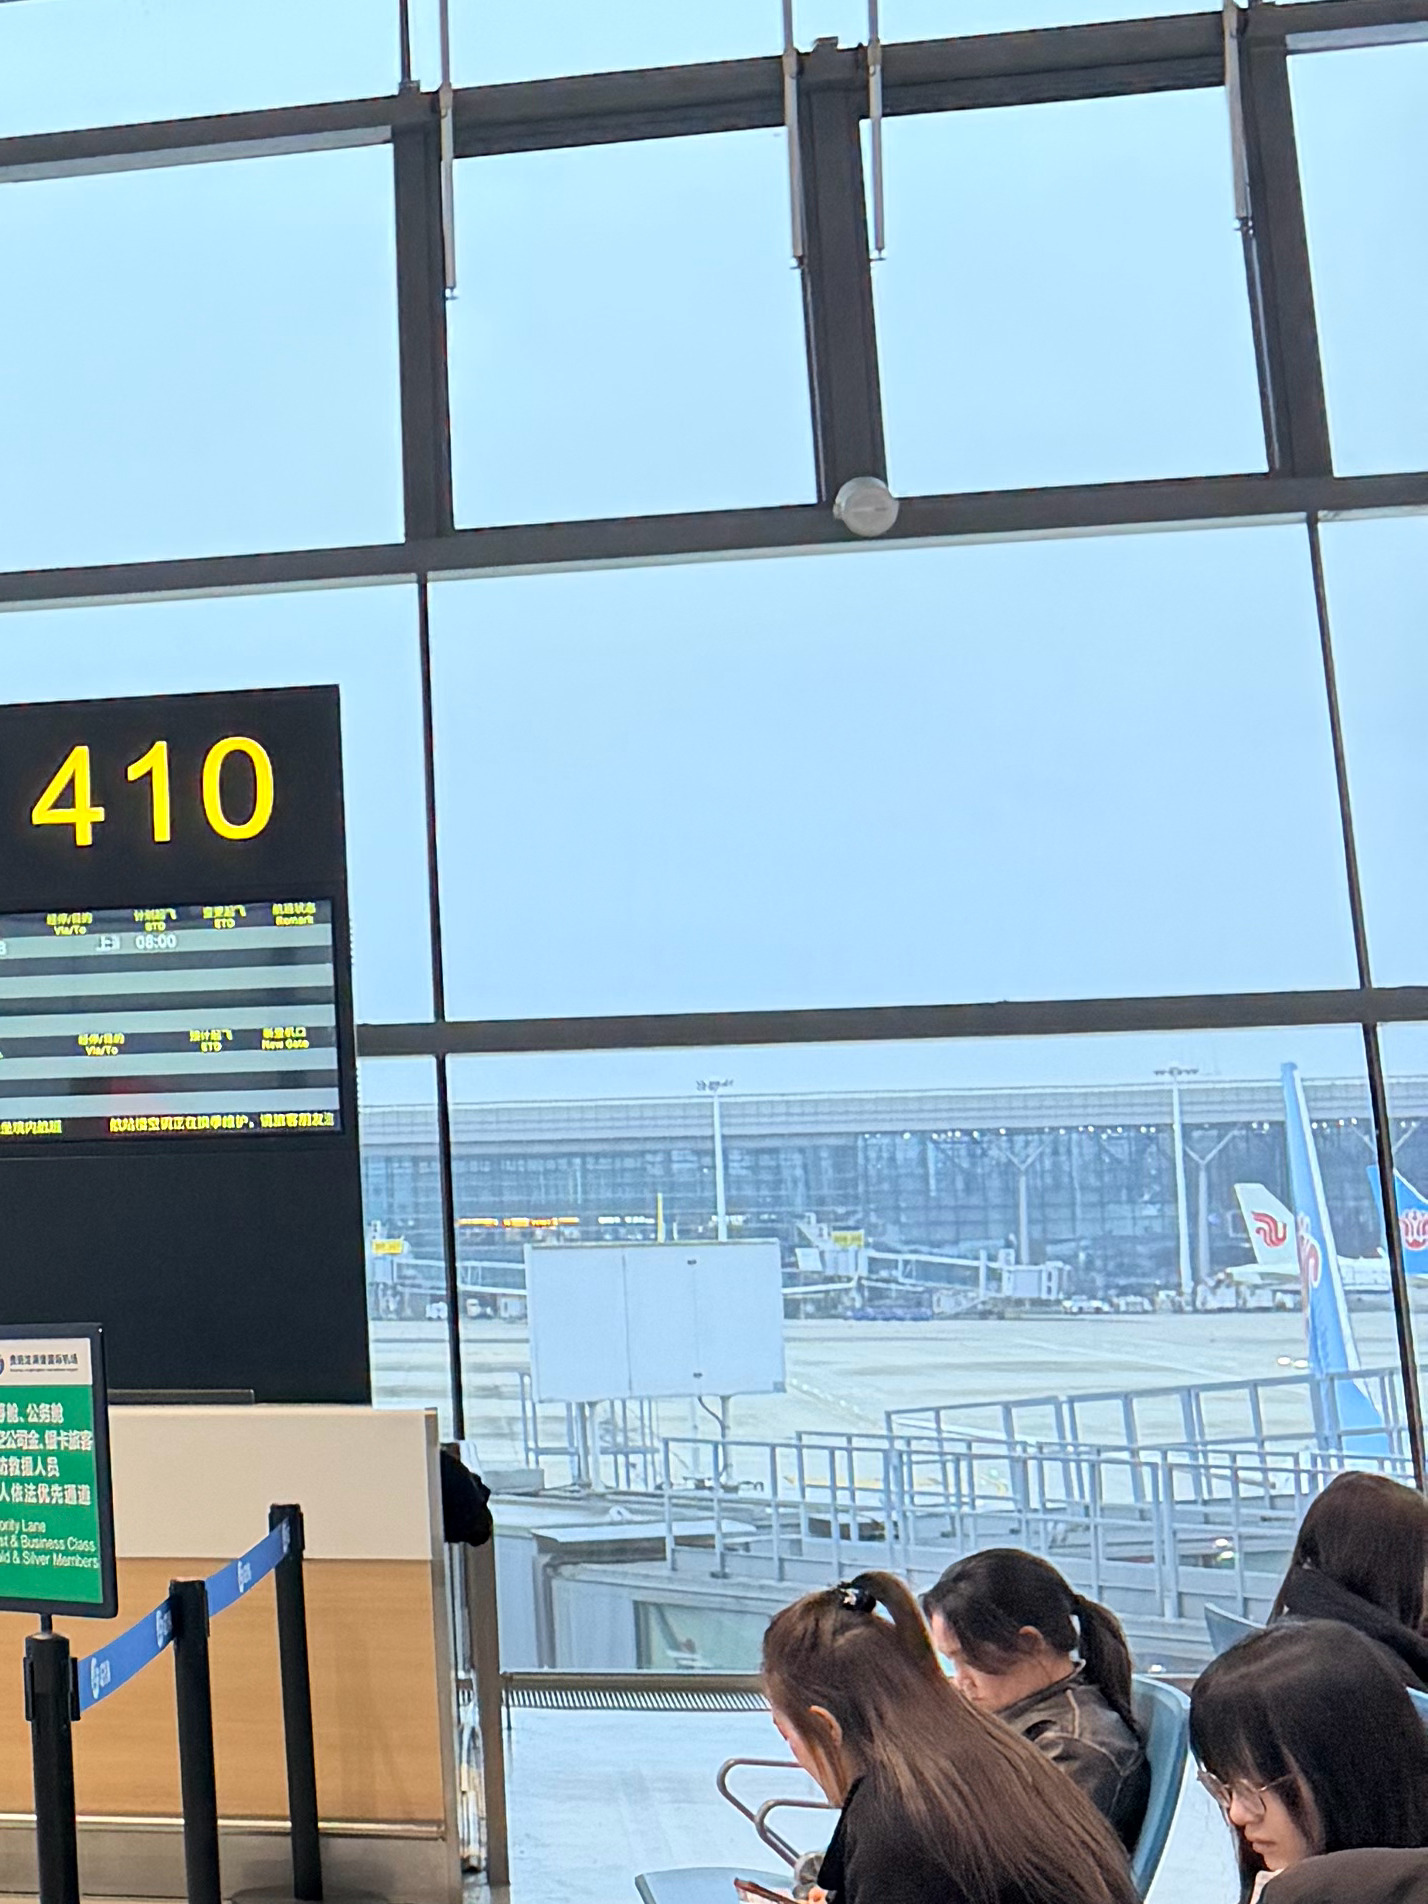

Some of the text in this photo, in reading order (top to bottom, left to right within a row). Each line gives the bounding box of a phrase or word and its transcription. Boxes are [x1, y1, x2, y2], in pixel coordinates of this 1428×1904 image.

[31, 735, 275, 848] 410
[135, 934, 177, 950] 08:00
[21, 1519, 47, 1533] Lane
[10, 1534, 19, 1548] &
[20, 1534, 65, 1551] Business
[66, 1536, 96, 1552] Class
[12, 1550, 21, 1564] &
[22, 1550, 51, 1566] Silver
[52, 1552, 100, 1569] Members
